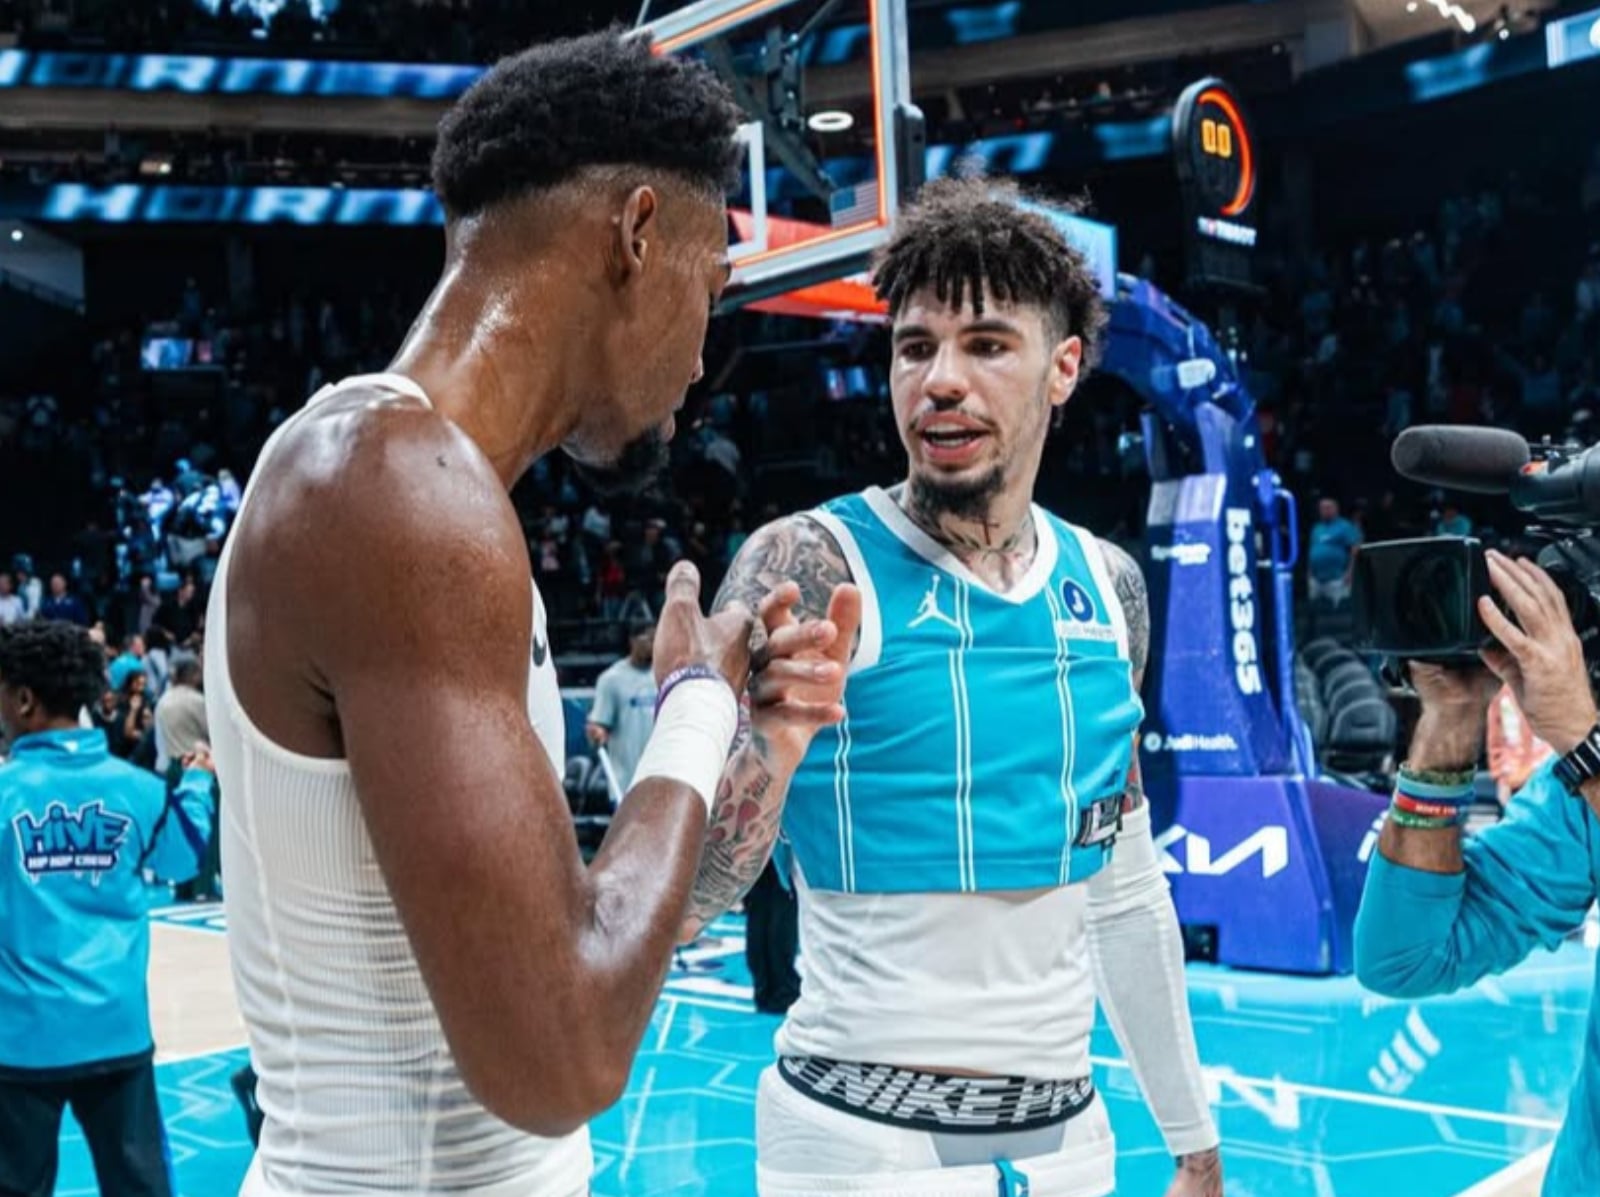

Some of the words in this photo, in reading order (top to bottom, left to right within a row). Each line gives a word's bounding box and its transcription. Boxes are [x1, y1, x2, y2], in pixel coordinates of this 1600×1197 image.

[1201, 118, 1232, 159] 00
[1225, 508, 1262, 695] bet365
[811, 1060, 1010, 1126] NIKE
